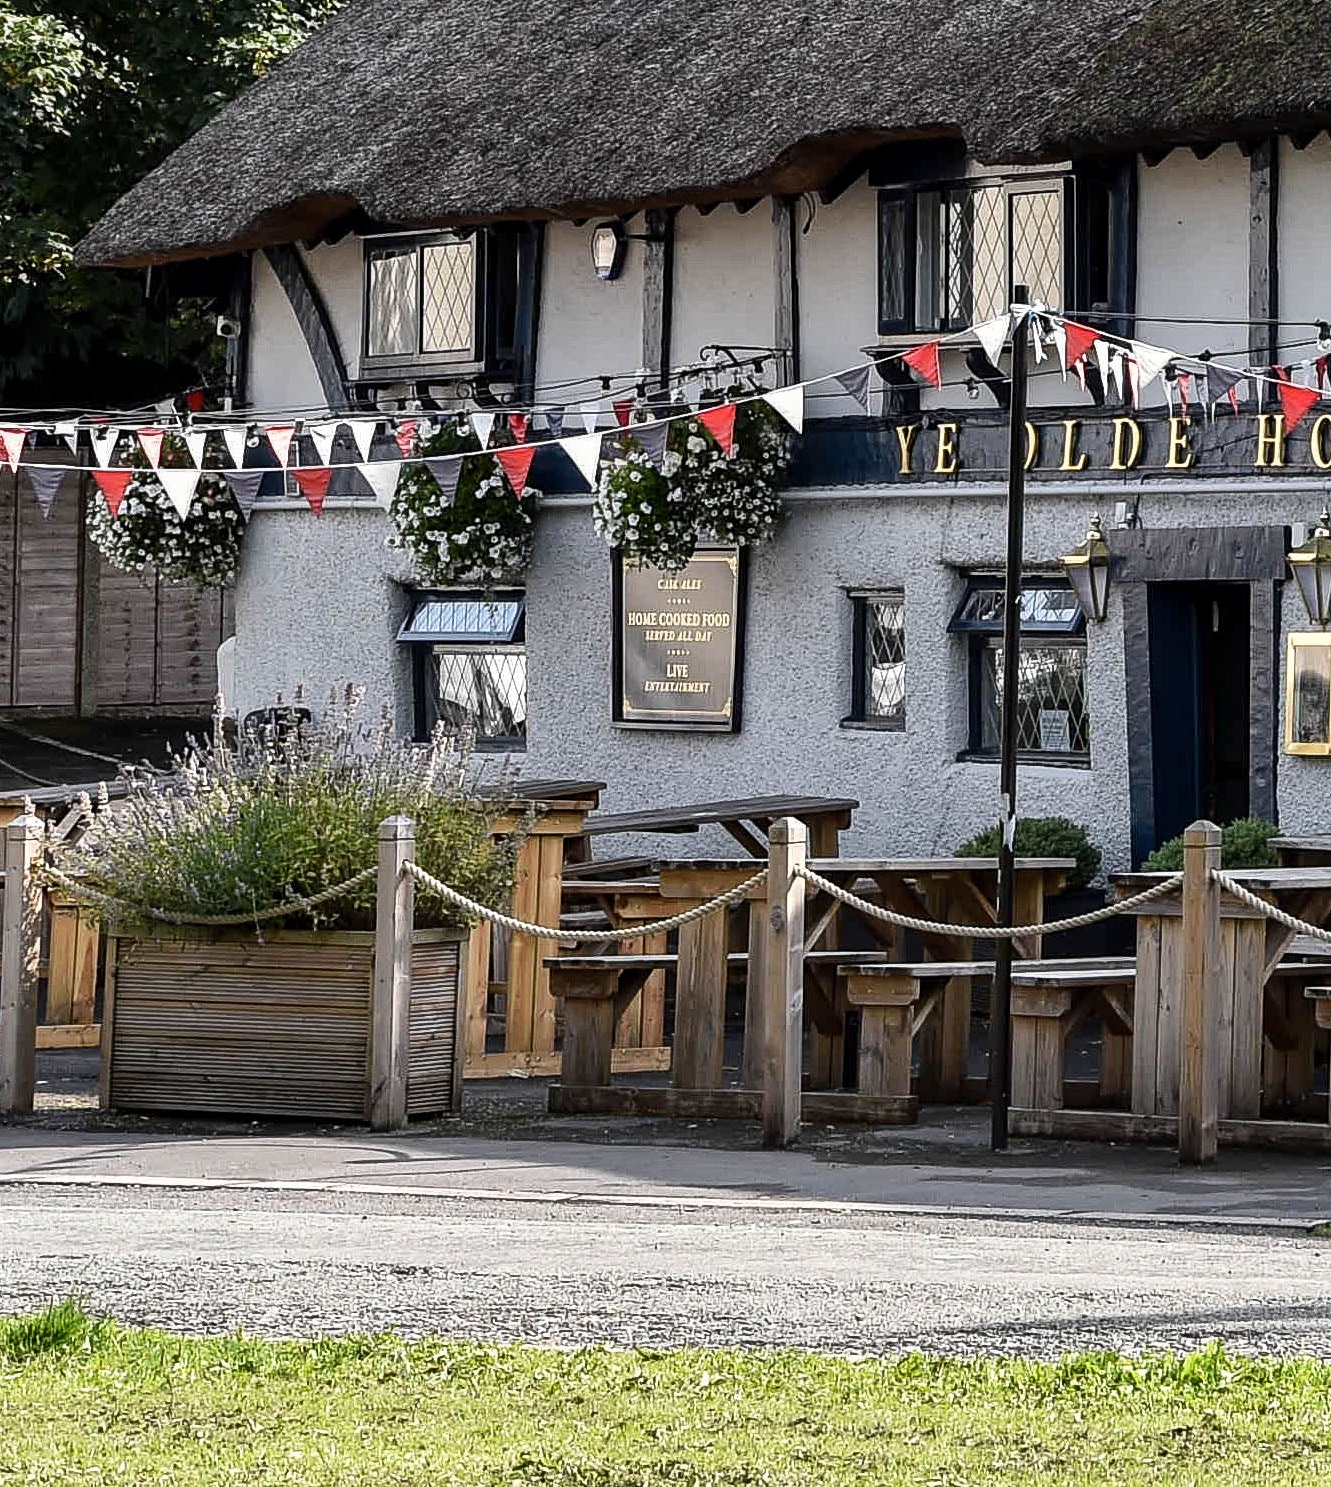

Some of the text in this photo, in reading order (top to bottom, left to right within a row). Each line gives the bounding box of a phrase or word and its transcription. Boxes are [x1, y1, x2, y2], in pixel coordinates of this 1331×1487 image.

[895, 422, 959, 474] YE
[628, 612, 731, 627] HOME COOKED FOOD
[666, 664, 689, 678] LIVE
